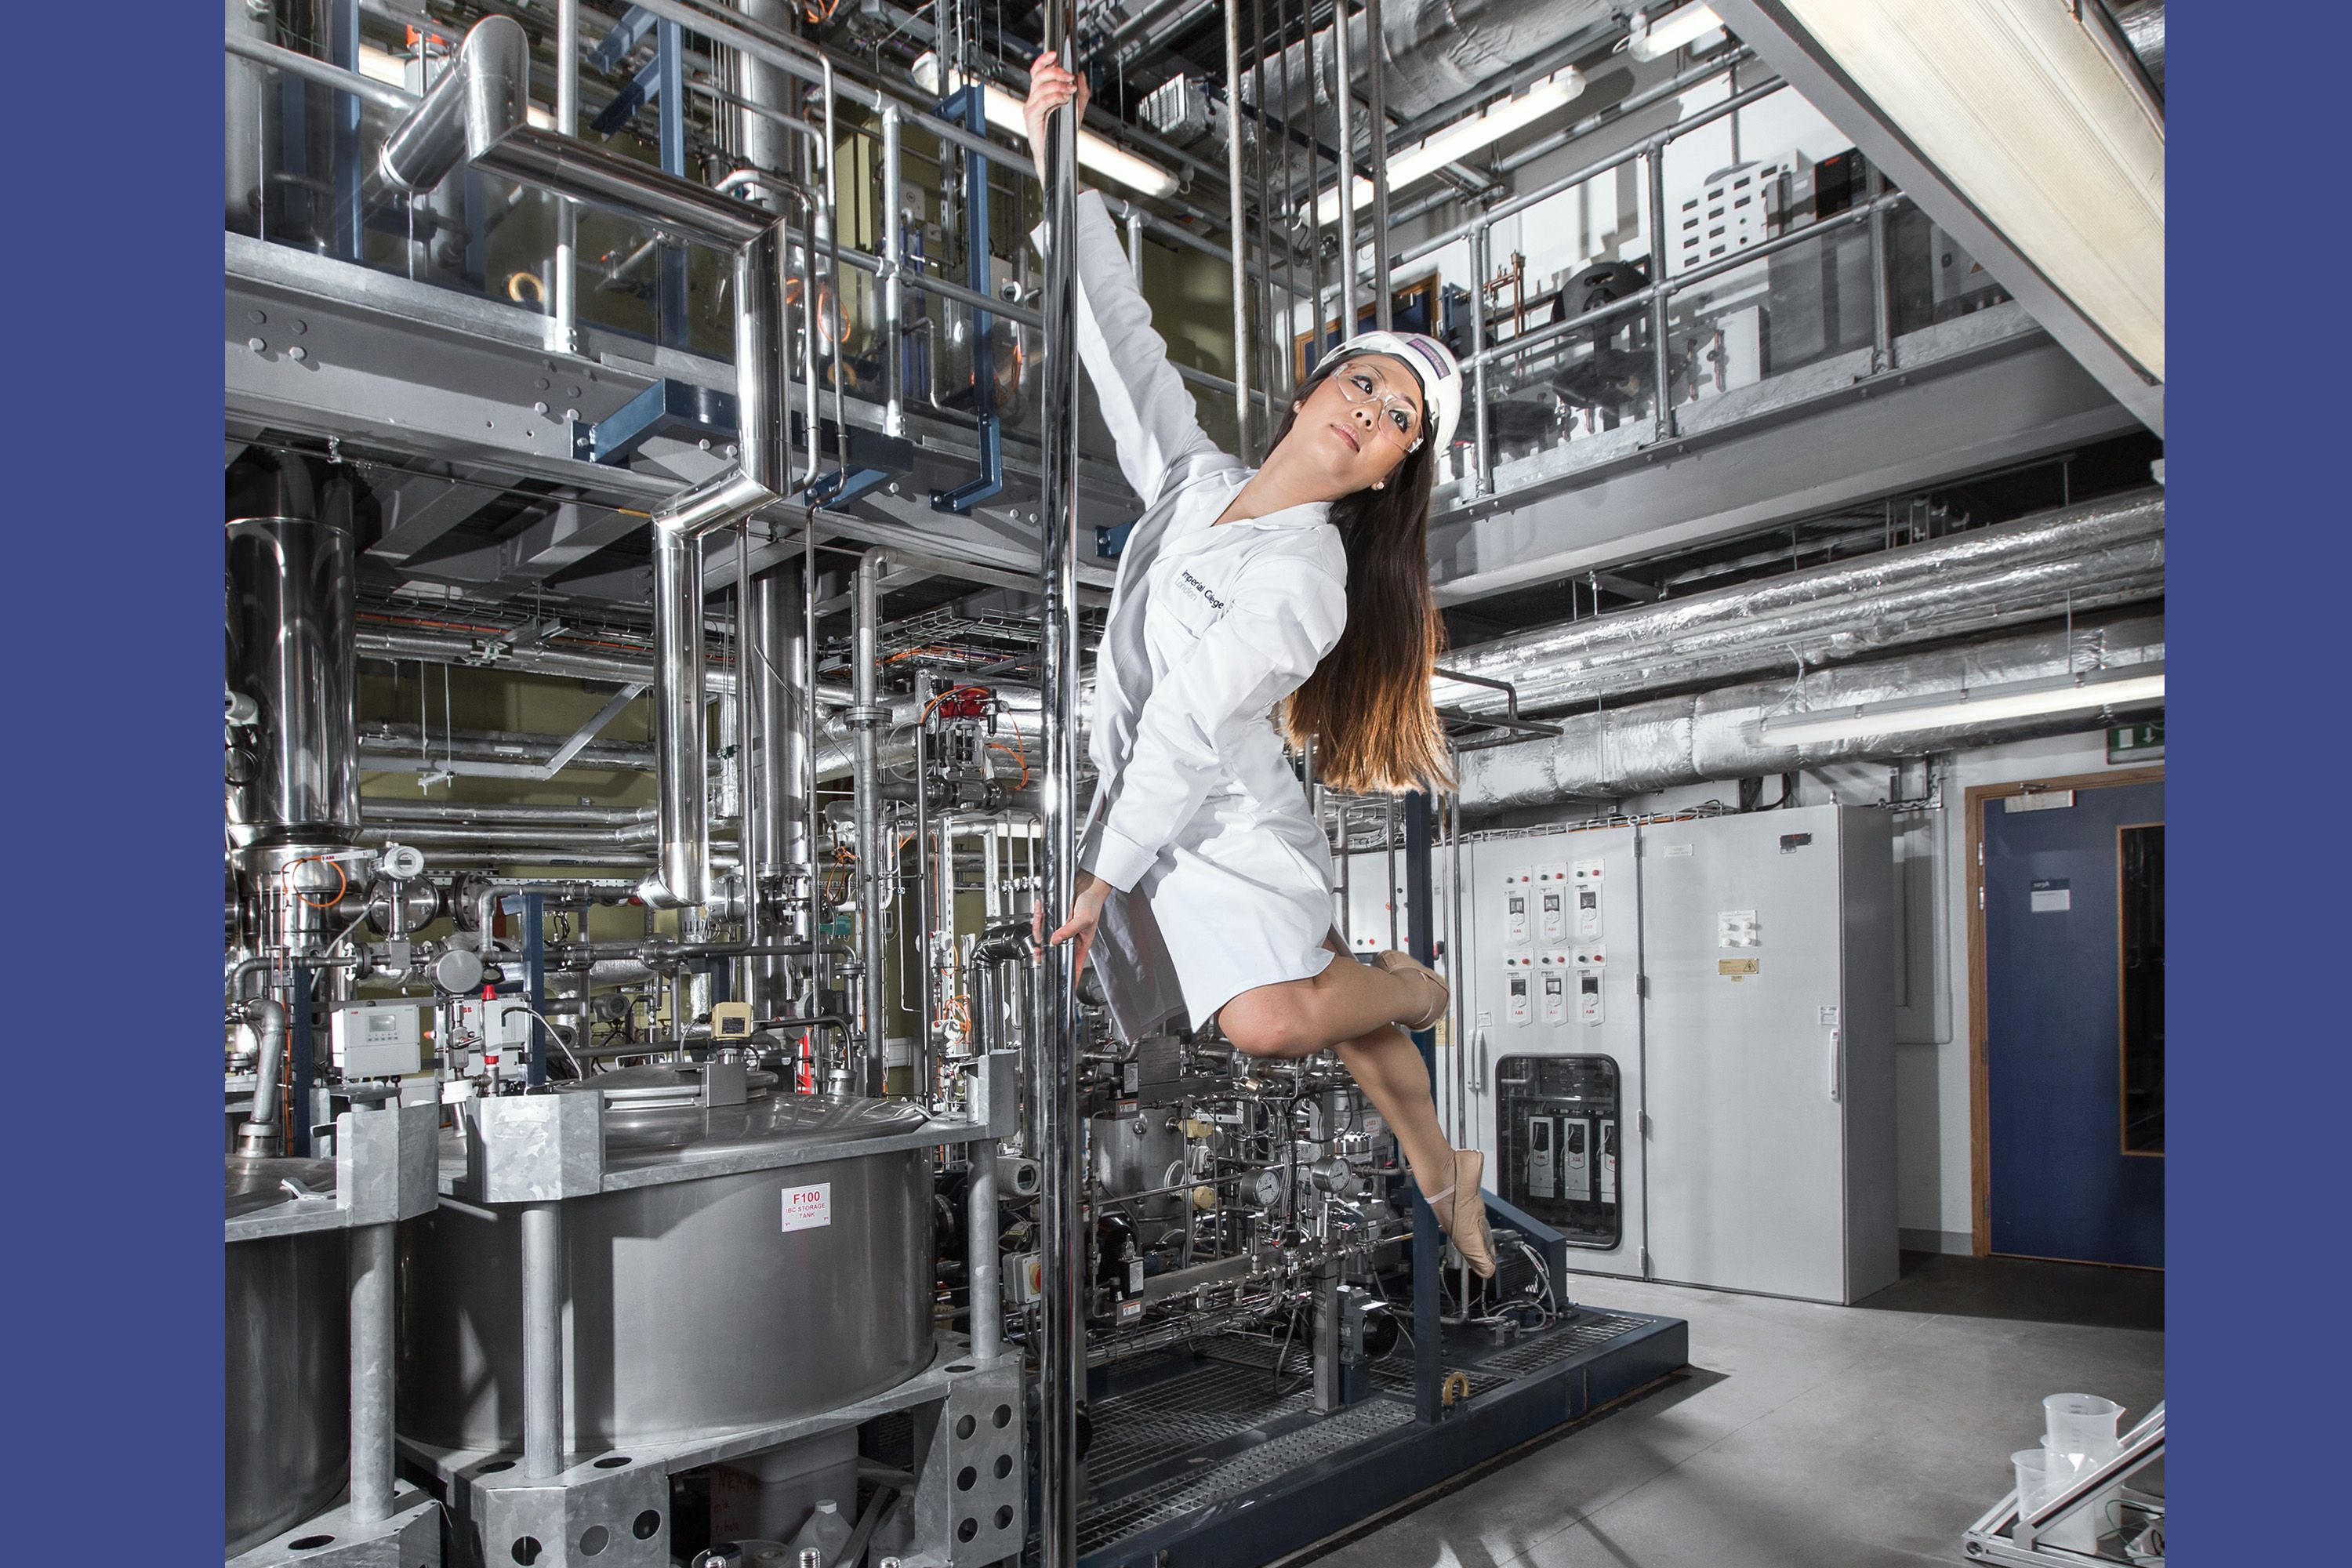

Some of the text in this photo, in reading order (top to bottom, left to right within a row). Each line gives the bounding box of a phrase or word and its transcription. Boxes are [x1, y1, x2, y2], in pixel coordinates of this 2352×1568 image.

[1181, 569, 1206, 593] Imperial
[793, 1191, 820, 1204] F100
[798, 1203, 826, 1212] STORAGE
